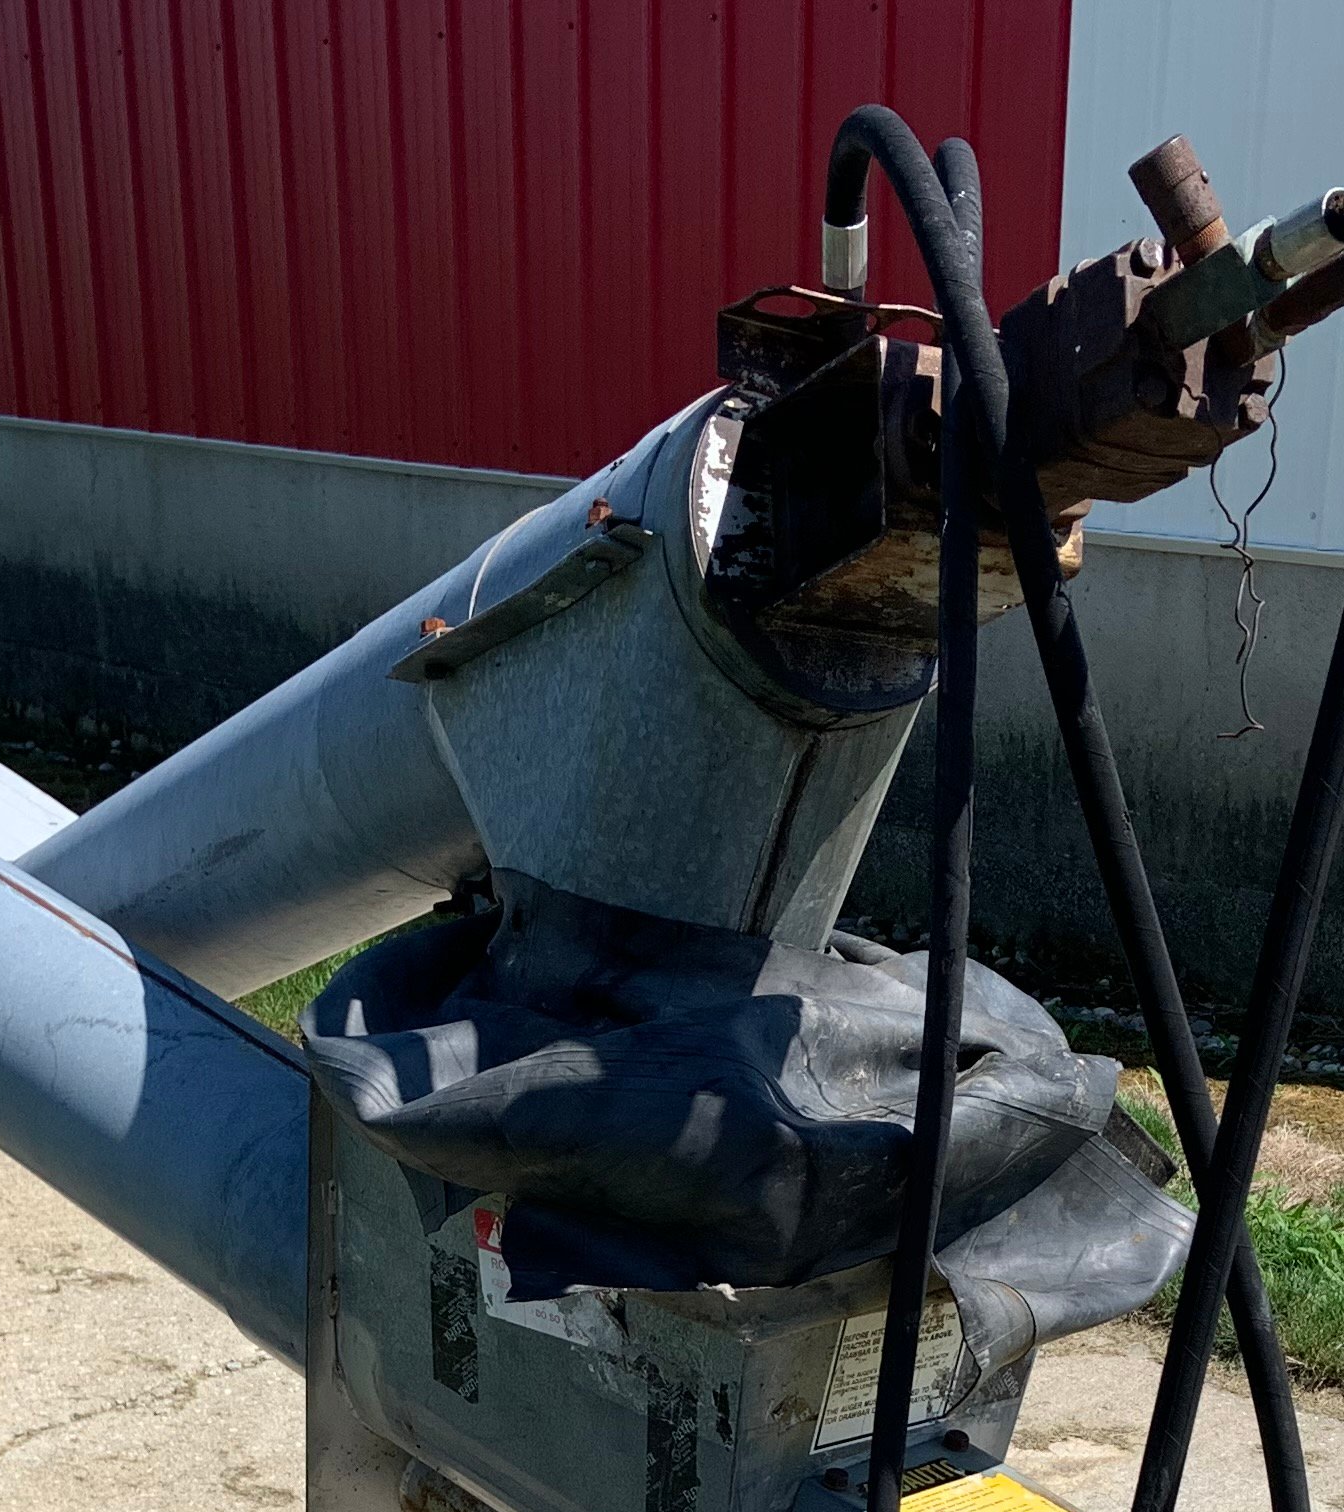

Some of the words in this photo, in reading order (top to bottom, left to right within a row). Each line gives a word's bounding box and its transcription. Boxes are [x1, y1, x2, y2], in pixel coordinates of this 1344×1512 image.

[843, 1330, 869, 1343] BEFORE
[842, 1339, 870, 1351] TRACTOR
[840, 1347, 871, 1361] DRAWBAR
[872, 1346, 880, 1354] IS
[826, 1407, 840, 1417] THE
[840, 1401, 863, 1413] AUGER
[838, 1409, 871, 1422] DRAWBAR
